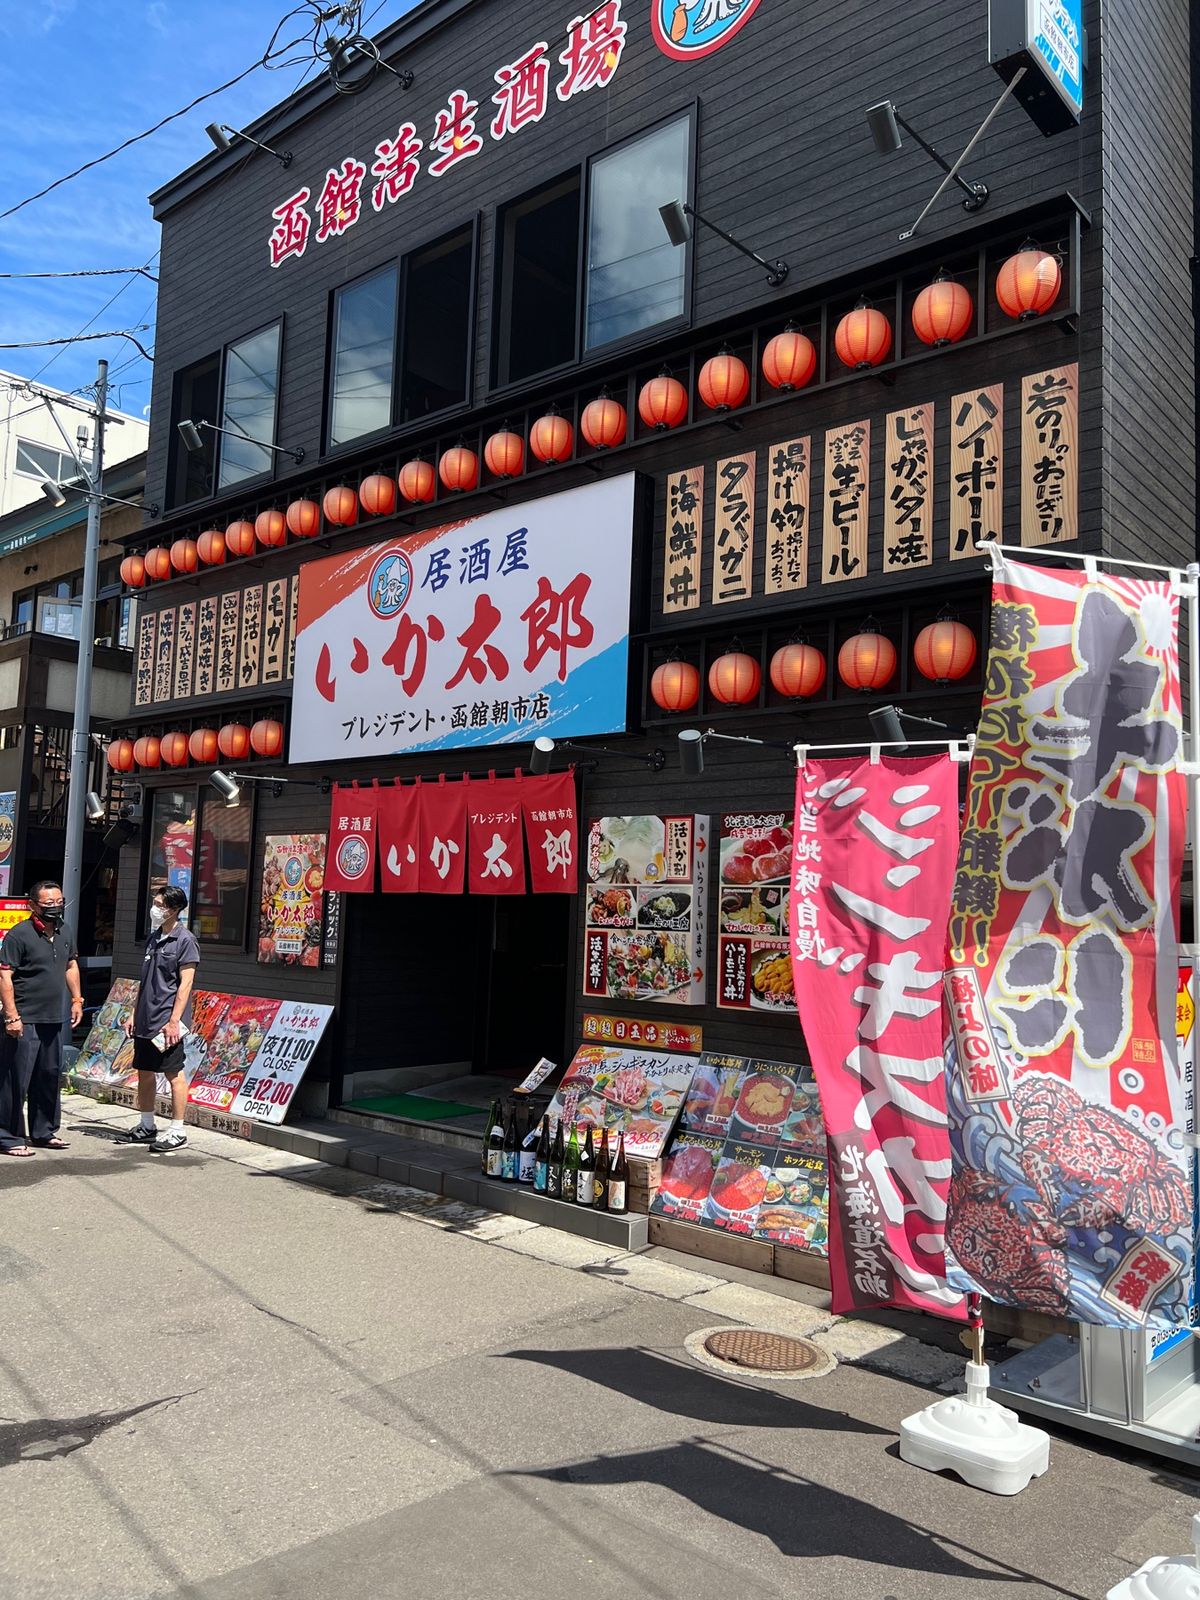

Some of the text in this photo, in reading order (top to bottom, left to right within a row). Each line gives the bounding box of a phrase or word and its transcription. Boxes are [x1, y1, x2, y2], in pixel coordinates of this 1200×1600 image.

[269, 0, 627, 268] 函館活生酒場
[953, 393, 998, 552] ハイボール
[1027, 374, 1074, 539] 岩のりのおにぎり
[770, 442, 807, 531] 揚げ物
[888, 410, 929, 566] じゃがバター焼
[668, 474, 699, 607] 海鮮丼
[718, 461, 750, 600] タラバガニ
[829, 463, 866, 576] 生ビール
[421, 527, 530, 593] 居酒屋
[138, 616, 155, 703] 北海道の野菜
[159, 612, 173, 661] 焼肉
[242, 613, 261, 684] 活いか
[266, 583, 284, 680] 毛ガニ
[315, 572, 595, 703] いか太郎
[338, 816, 372, 831] 居酒屋
[471, 813, 518, 824] プレジデント
[530, 808, 573, 822] 函館朝市店
[387, 829, 573, 880] いか太郎
[673, 821, 689, 877] 活いか刺
[267, 904, 315, 922] いか太郎
[723, 943, 738, 1000] ハーモニー丼
[262, 1034, 316, 1062] 夜11:00
[279, 1015, 321, 1030] いか太郎
[262, 1056, 297, 1072] CLOSE
[706, 1056, 743, 1069] いか太郎丼
[240, 1076, 294, 1106] 昼12:00
[243, 1100, 273, 1116] OPEN
[783, 1154, 824, 1171] ホッケ定食
